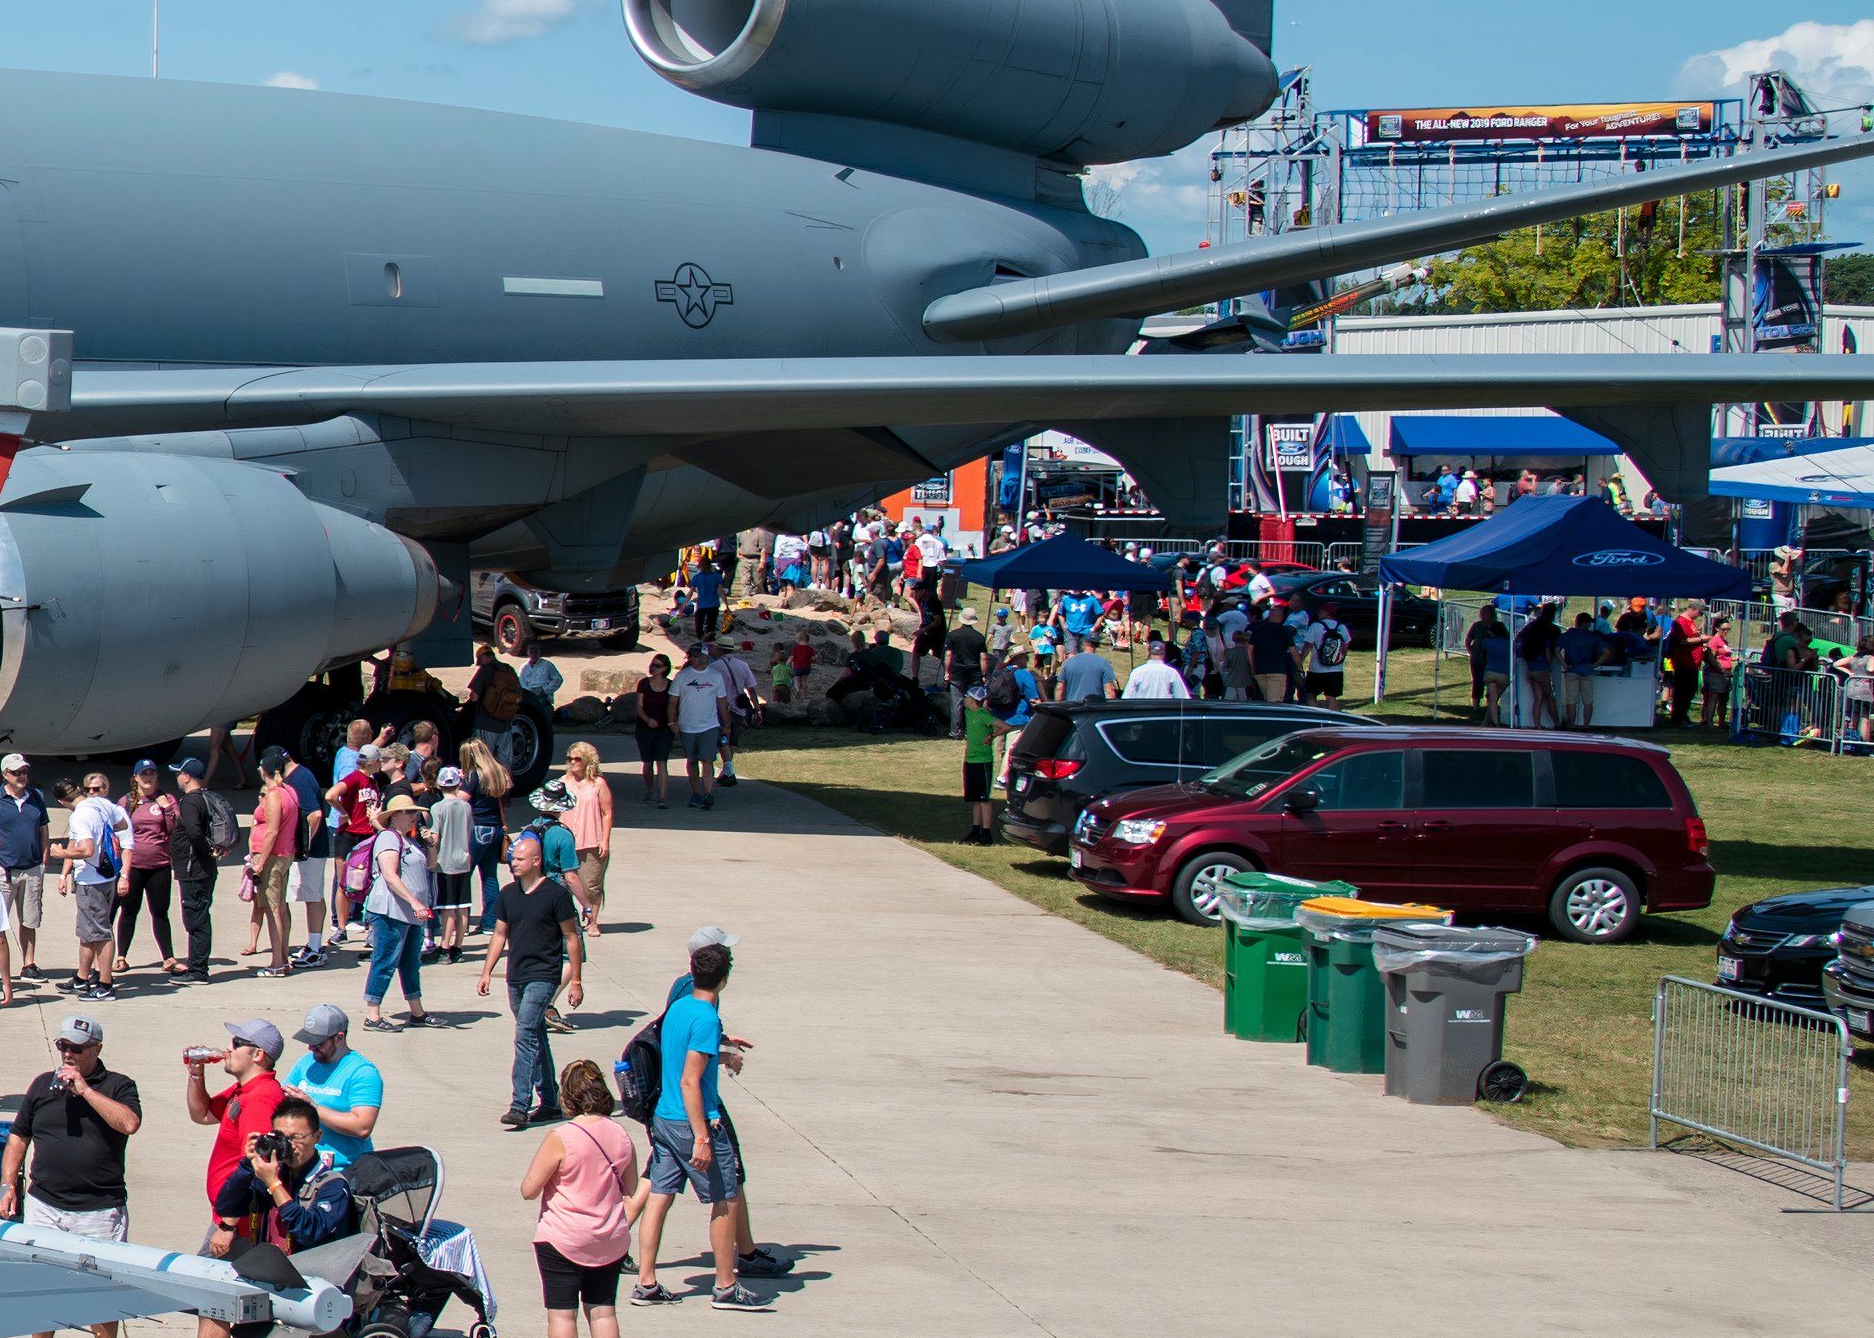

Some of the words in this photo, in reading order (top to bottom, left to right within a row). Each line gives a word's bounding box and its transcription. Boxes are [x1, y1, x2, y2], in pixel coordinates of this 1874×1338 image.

[1416, 120, 1431, 129] THE
[1432, 119, 1469, 130] ALL-NEW
[1470, 118, 1489, 128] 2019
[1490, 117, 1512, 128] FORD
[1514, 117, 1548, 127] RANGER
[1271, 456, 1309, 465] OUGH
[1590, 552, 1651, 566] Ford
